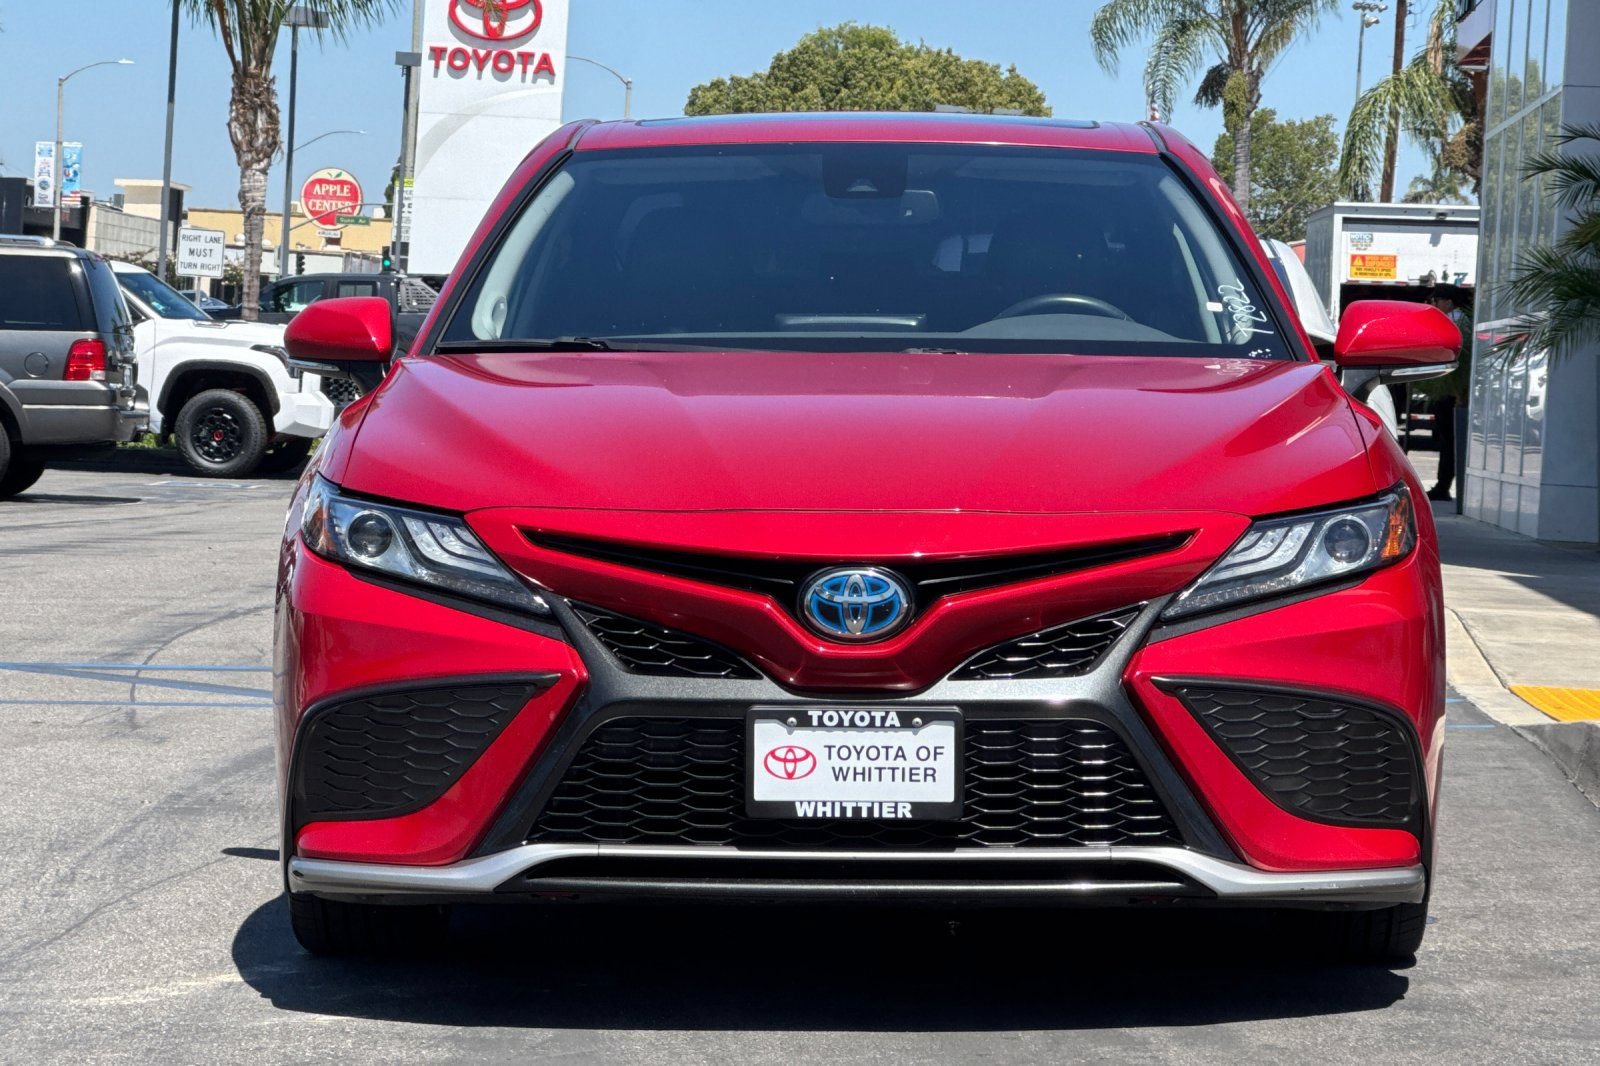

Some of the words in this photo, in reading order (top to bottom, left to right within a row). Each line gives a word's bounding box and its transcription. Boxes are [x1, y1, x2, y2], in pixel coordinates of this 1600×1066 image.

[429, 46, 556, 77] TOYOTA
[313, 183, 351, 197] APPLE
[308, 199, 353, 213] CENTER
[181, 234, 201, 242] RIGHT
[204, 236, 222, 244] LANE
[189, 248, 213, 258] MUST
[180, 261, 198, 269] TURN
[200, 263, 220, 271] RIGHT
[808, 710, 901, 728] TOYOTA
[824, 745, 907, 762] TOYOTA
[916, 745, 945, 762] OF
[832, 766, 937, 783] WHITTIER
[795, 801, 913, 818] WHITTIER
